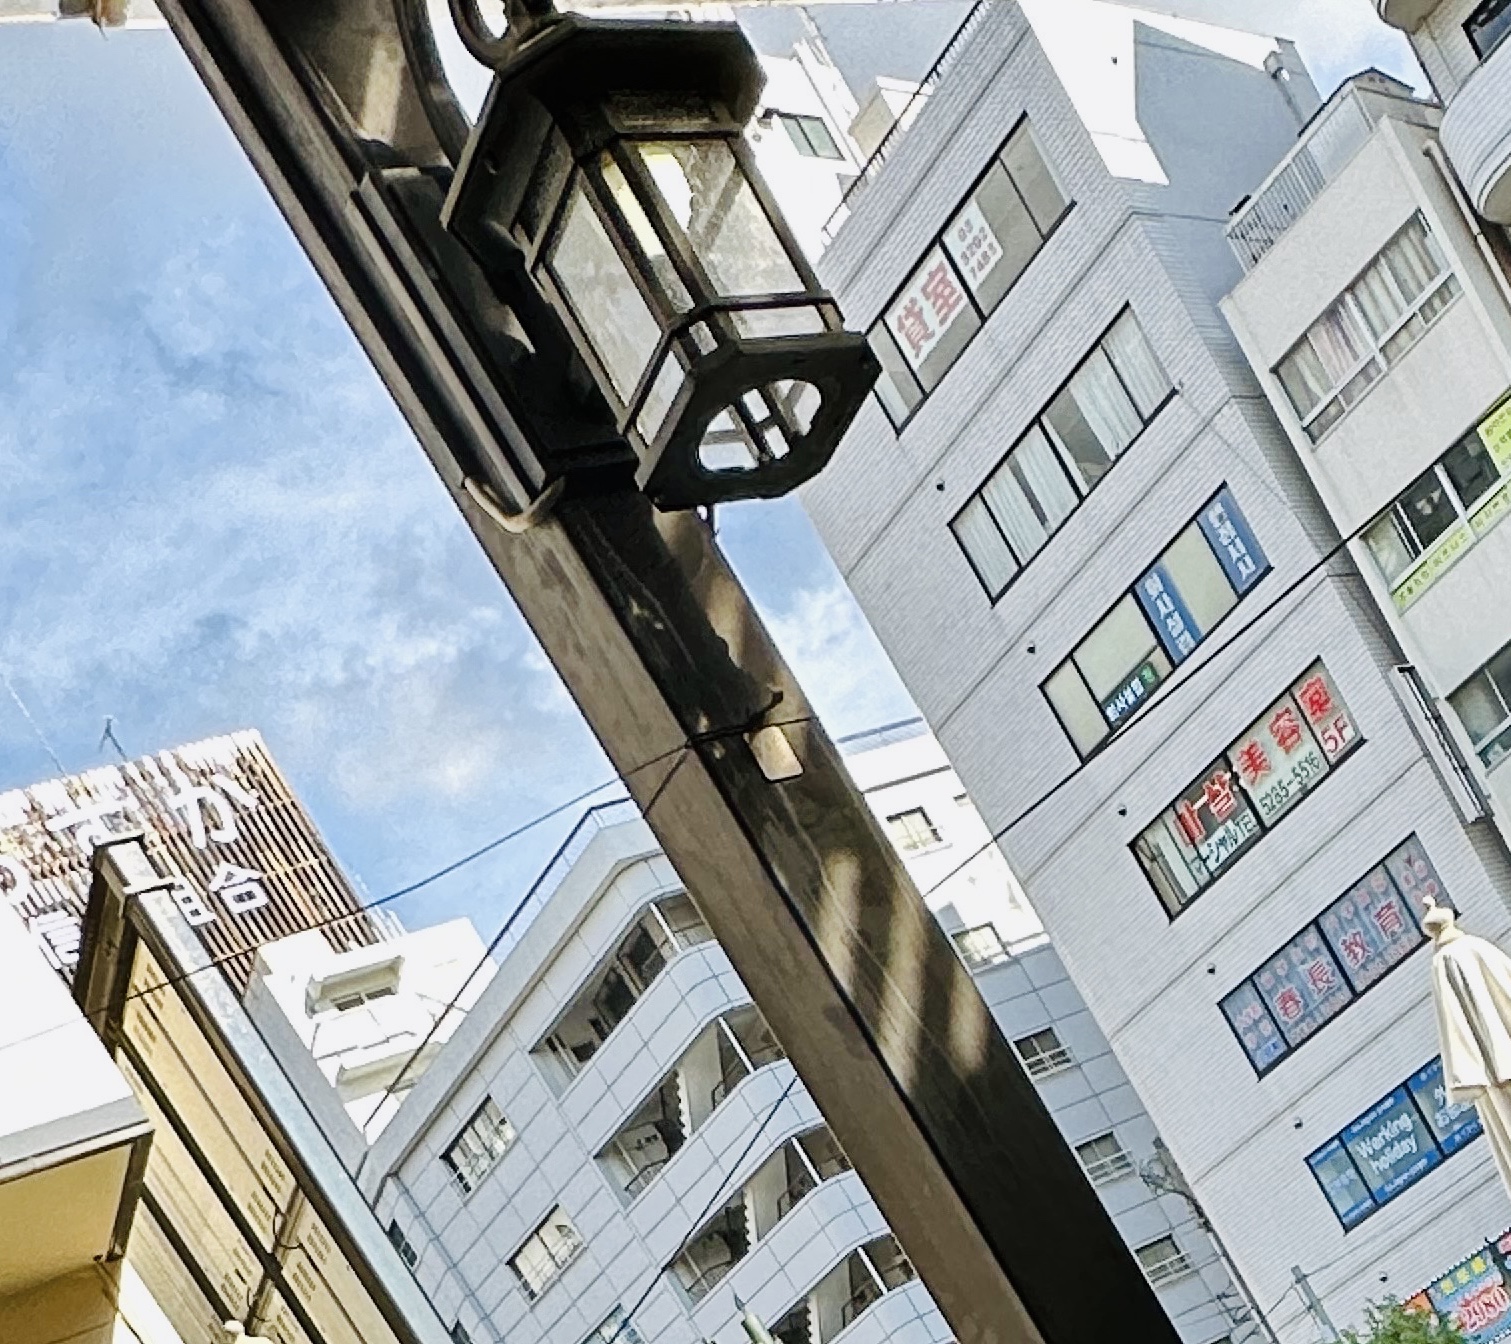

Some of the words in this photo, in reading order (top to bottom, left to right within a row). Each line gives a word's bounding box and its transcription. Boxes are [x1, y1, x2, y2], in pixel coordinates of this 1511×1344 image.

[896, 260, 964, 359] 貸室
[1320, 711, 1350, 756] 5F
[1355, 1110, 1415, 1159] Working
[1369, 1131, 1418, 1175] holiday
